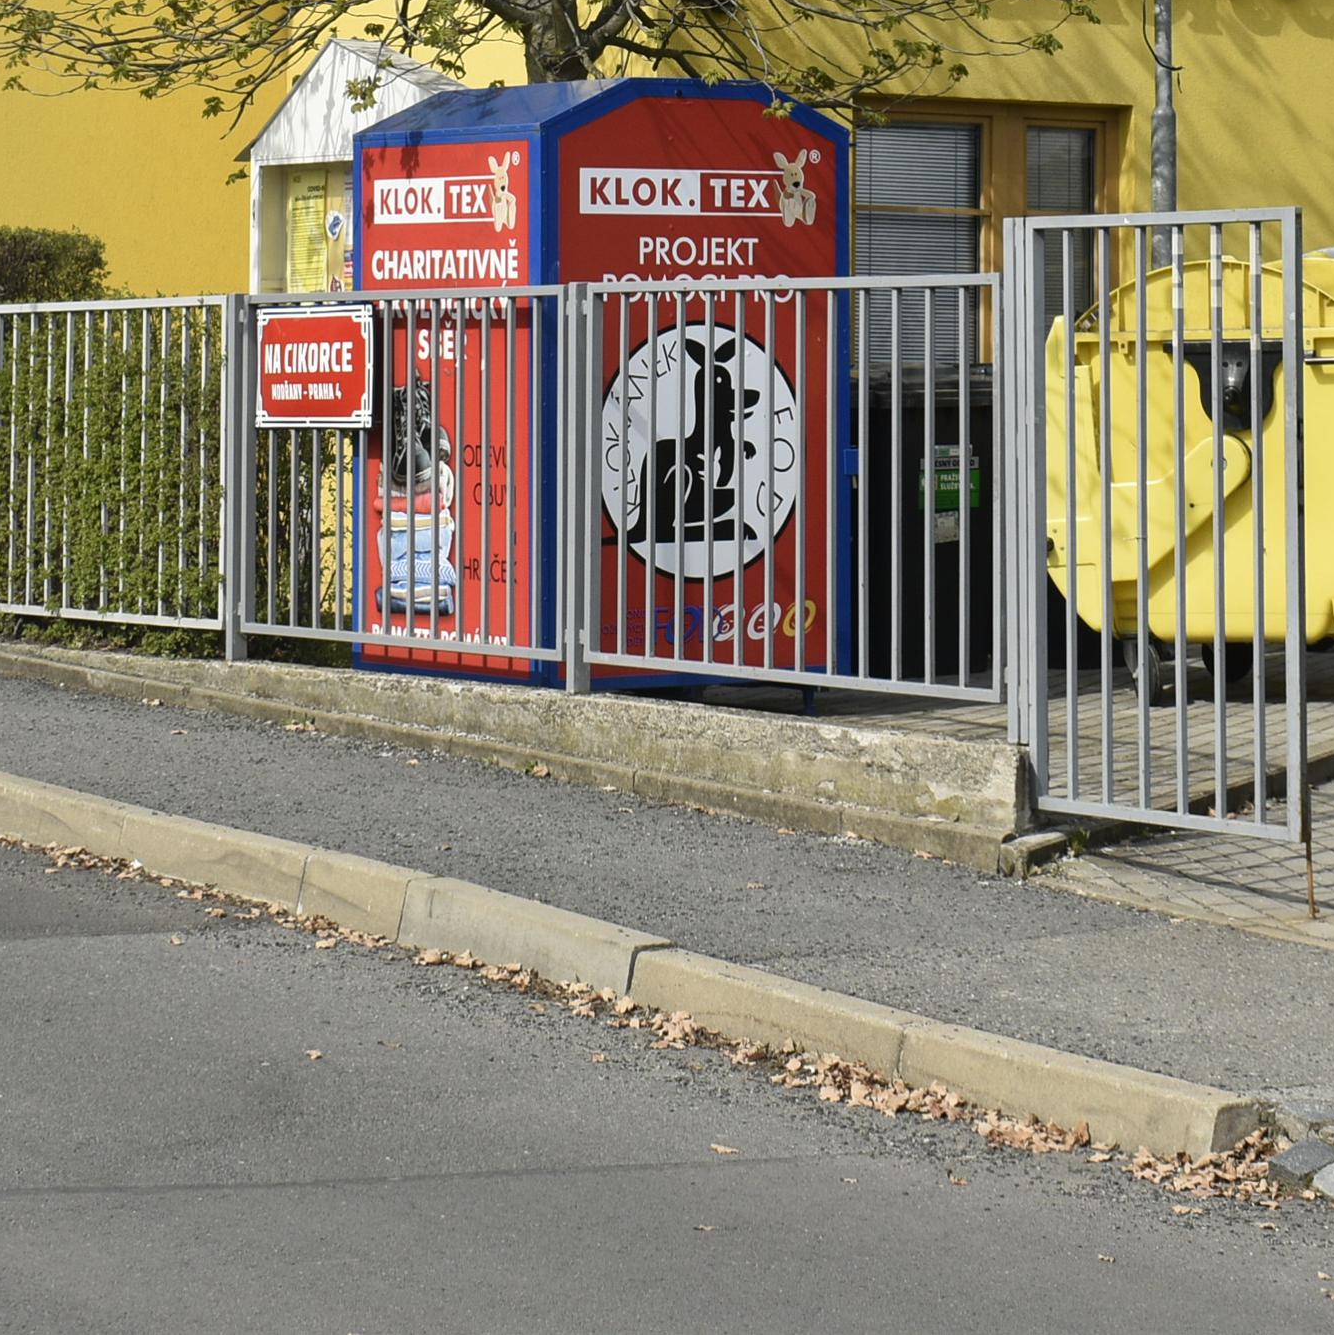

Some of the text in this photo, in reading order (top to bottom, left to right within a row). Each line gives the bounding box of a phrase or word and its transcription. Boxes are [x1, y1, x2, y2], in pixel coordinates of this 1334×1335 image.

[449, 183, 487, 215] TEX
[709, 178, 770, 209] TEX
[371, 238, 519, 281] CHARITATIVNĚ
[638, 236, 759, 267] PROJEKT
[417, 320, 468, 361] SĚ
[264, 341, 353, 374] NA CIKORCE
[308, 382, 335, 401] PRAHA
[335, 382, 343, 401] 4
